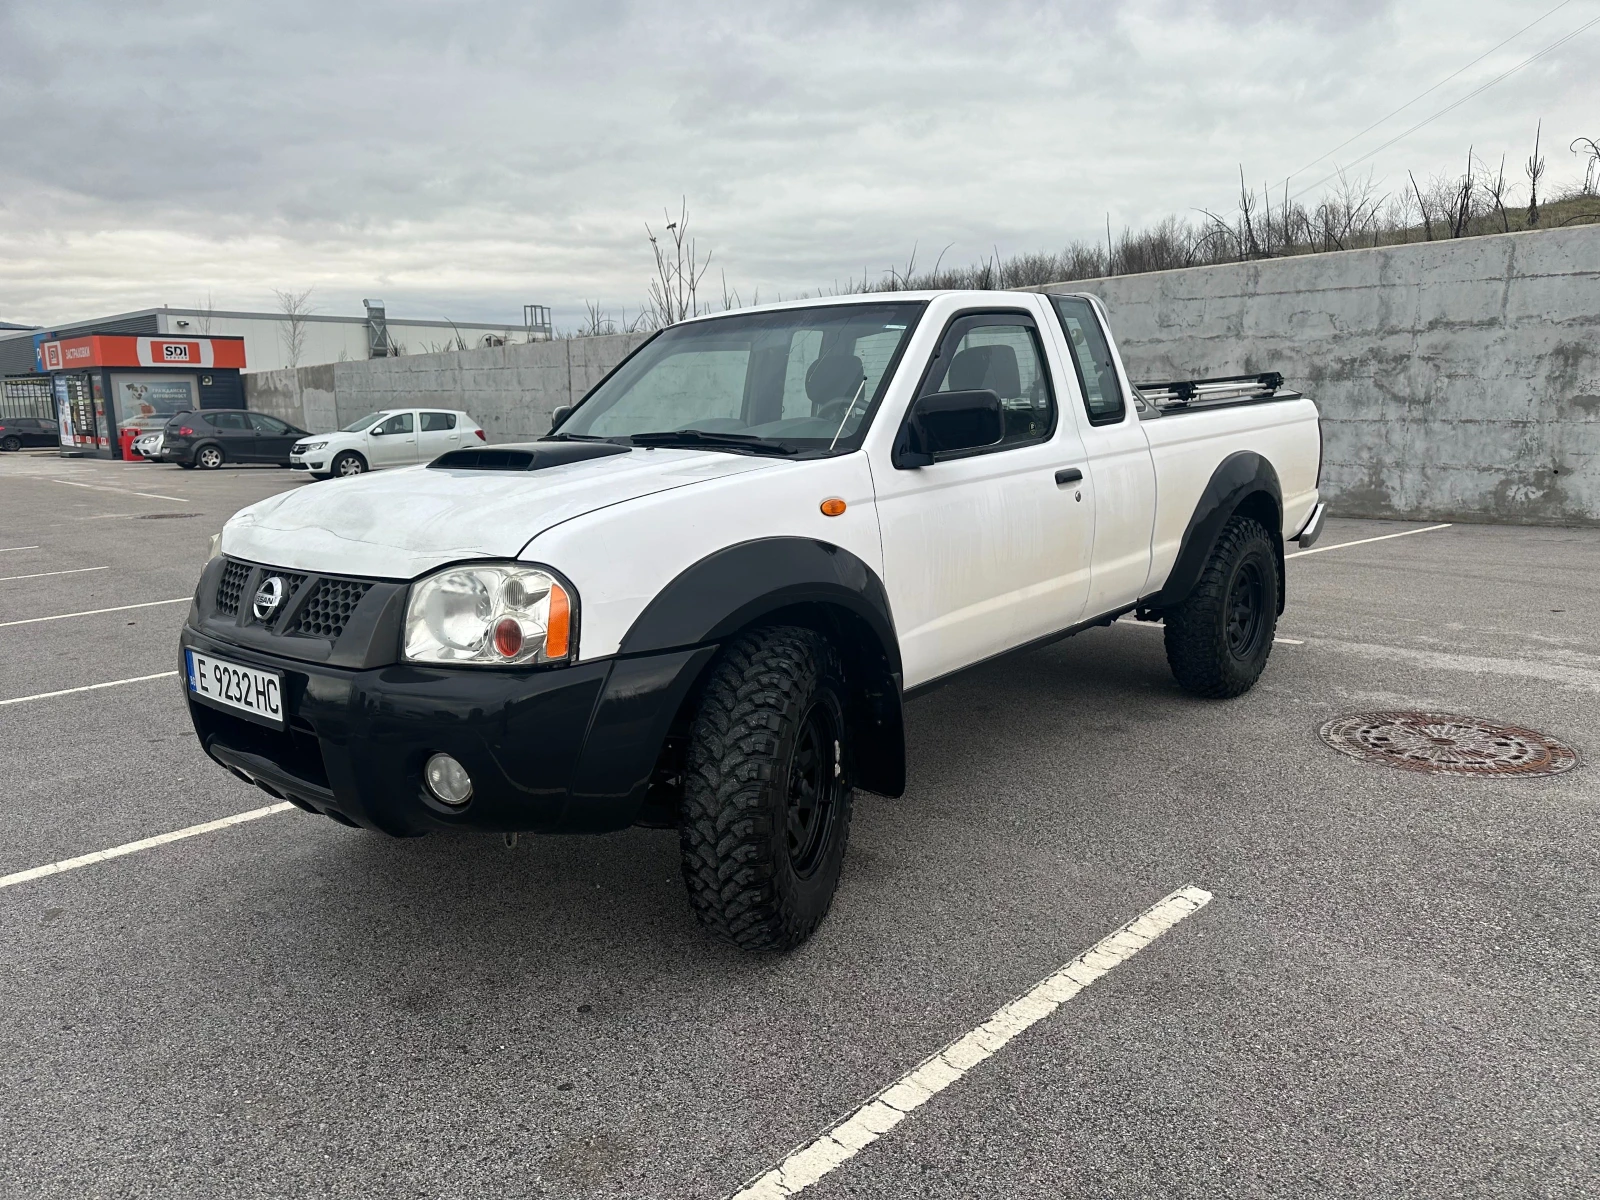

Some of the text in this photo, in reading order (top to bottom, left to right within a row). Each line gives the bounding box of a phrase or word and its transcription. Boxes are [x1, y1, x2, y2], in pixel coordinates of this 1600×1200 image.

[65, 346, 91, 360] ЗАСТРАХОВКИ
[165, 345, 187, 356] SDI
[197, 658, 210, 693] E
